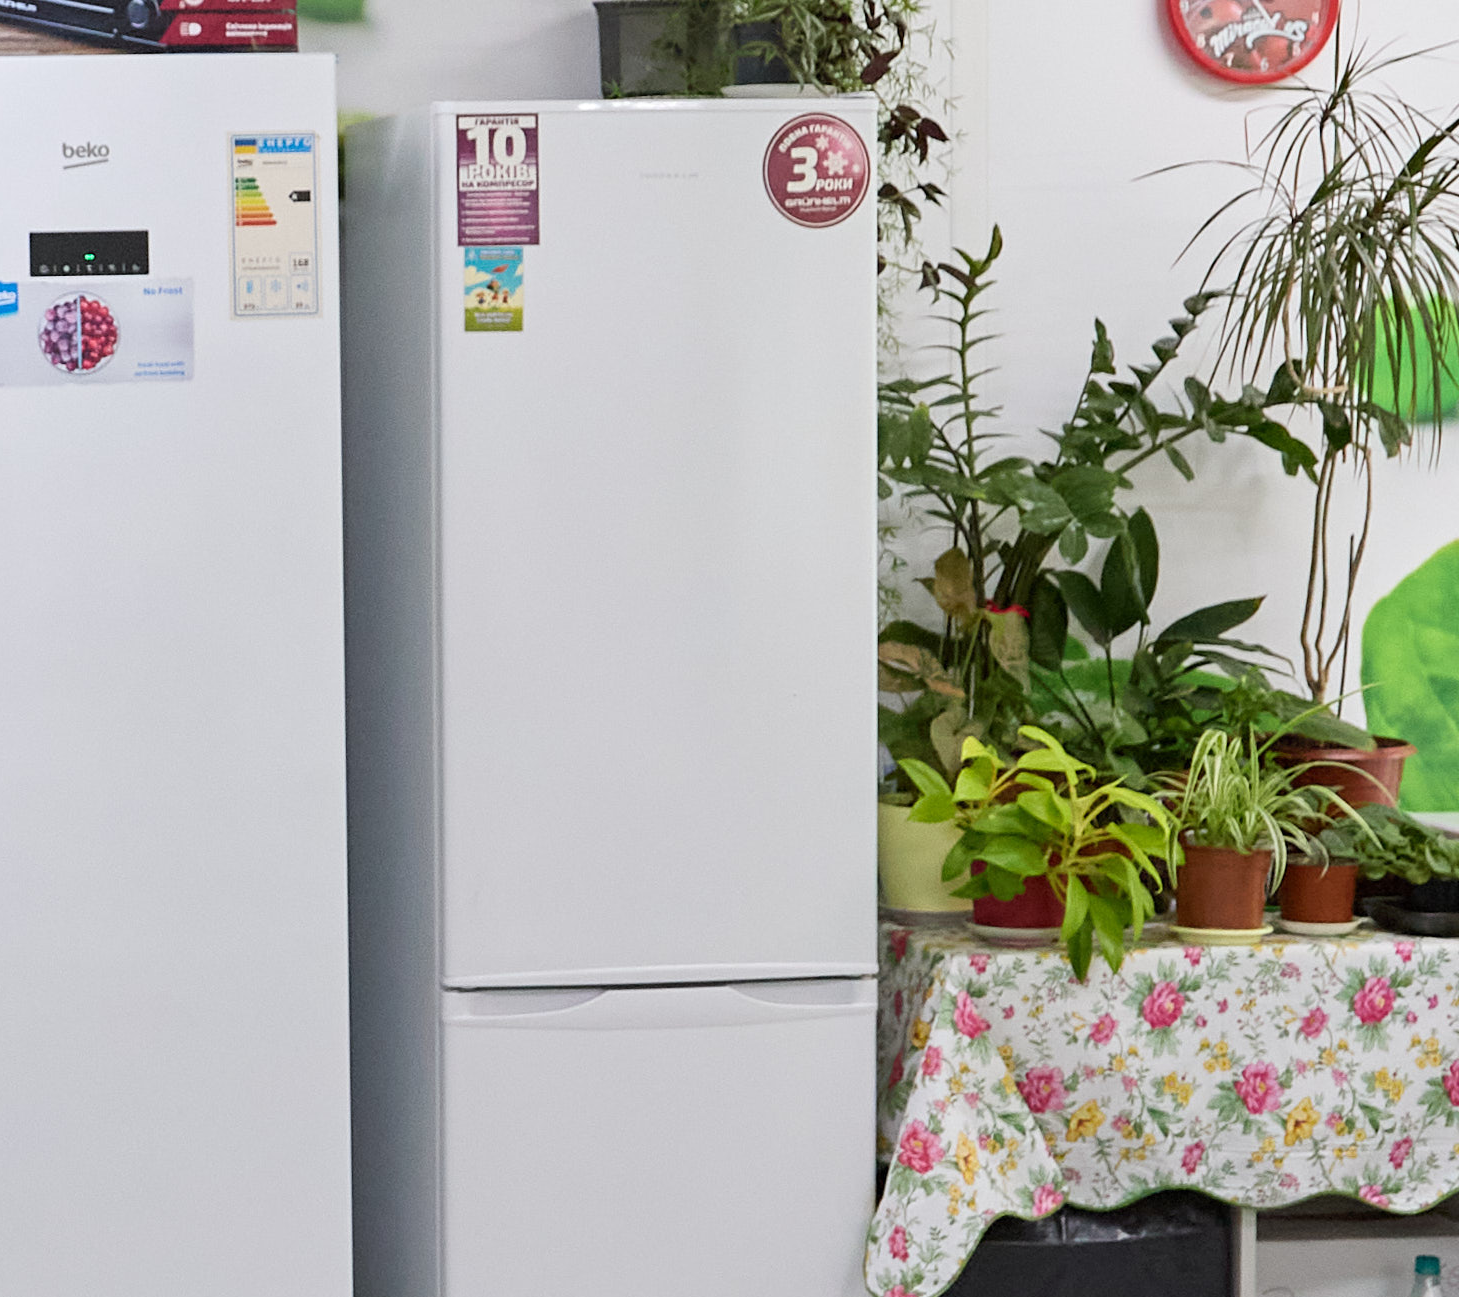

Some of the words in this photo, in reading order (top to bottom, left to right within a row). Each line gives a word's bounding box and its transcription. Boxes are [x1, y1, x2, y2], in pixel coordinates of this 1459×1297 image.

[62, 141, 110, 159] beko
[466, 126, 527, 165] 10
[786, 146, 819, 193] 3
[814, 177, 854, 192] РОКИ
